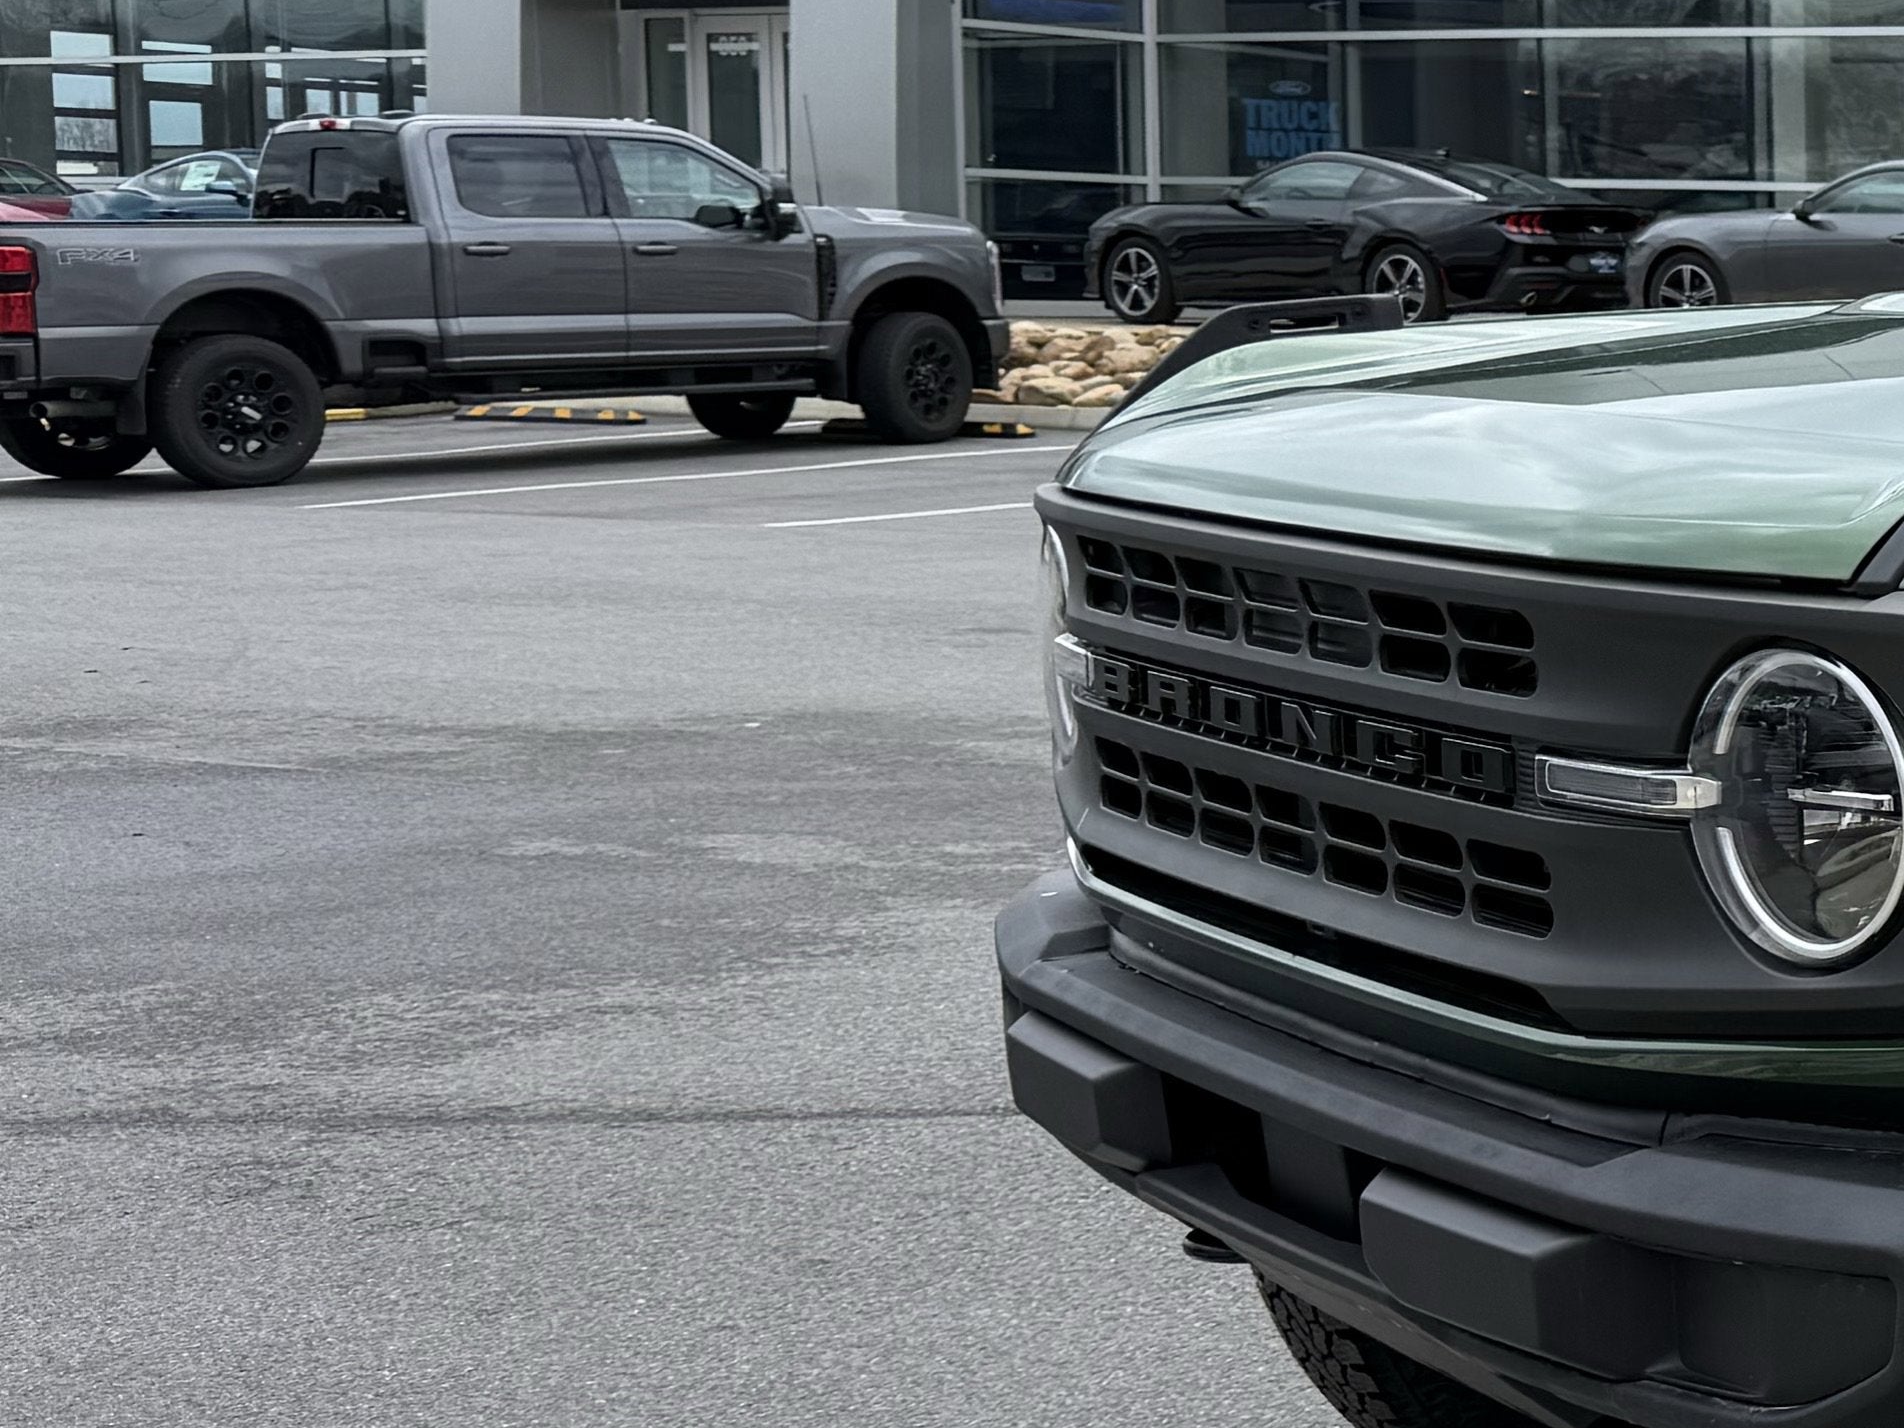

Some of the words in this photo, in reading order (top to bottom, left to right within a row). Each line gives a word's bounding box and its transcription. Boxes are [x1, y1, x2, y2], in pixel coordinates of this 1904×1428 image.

[1242, 97, 1340, 131] TRUCK
[57, 248, 137, 265] FX4
[1092, 657, 1516, 793] BRONCO
